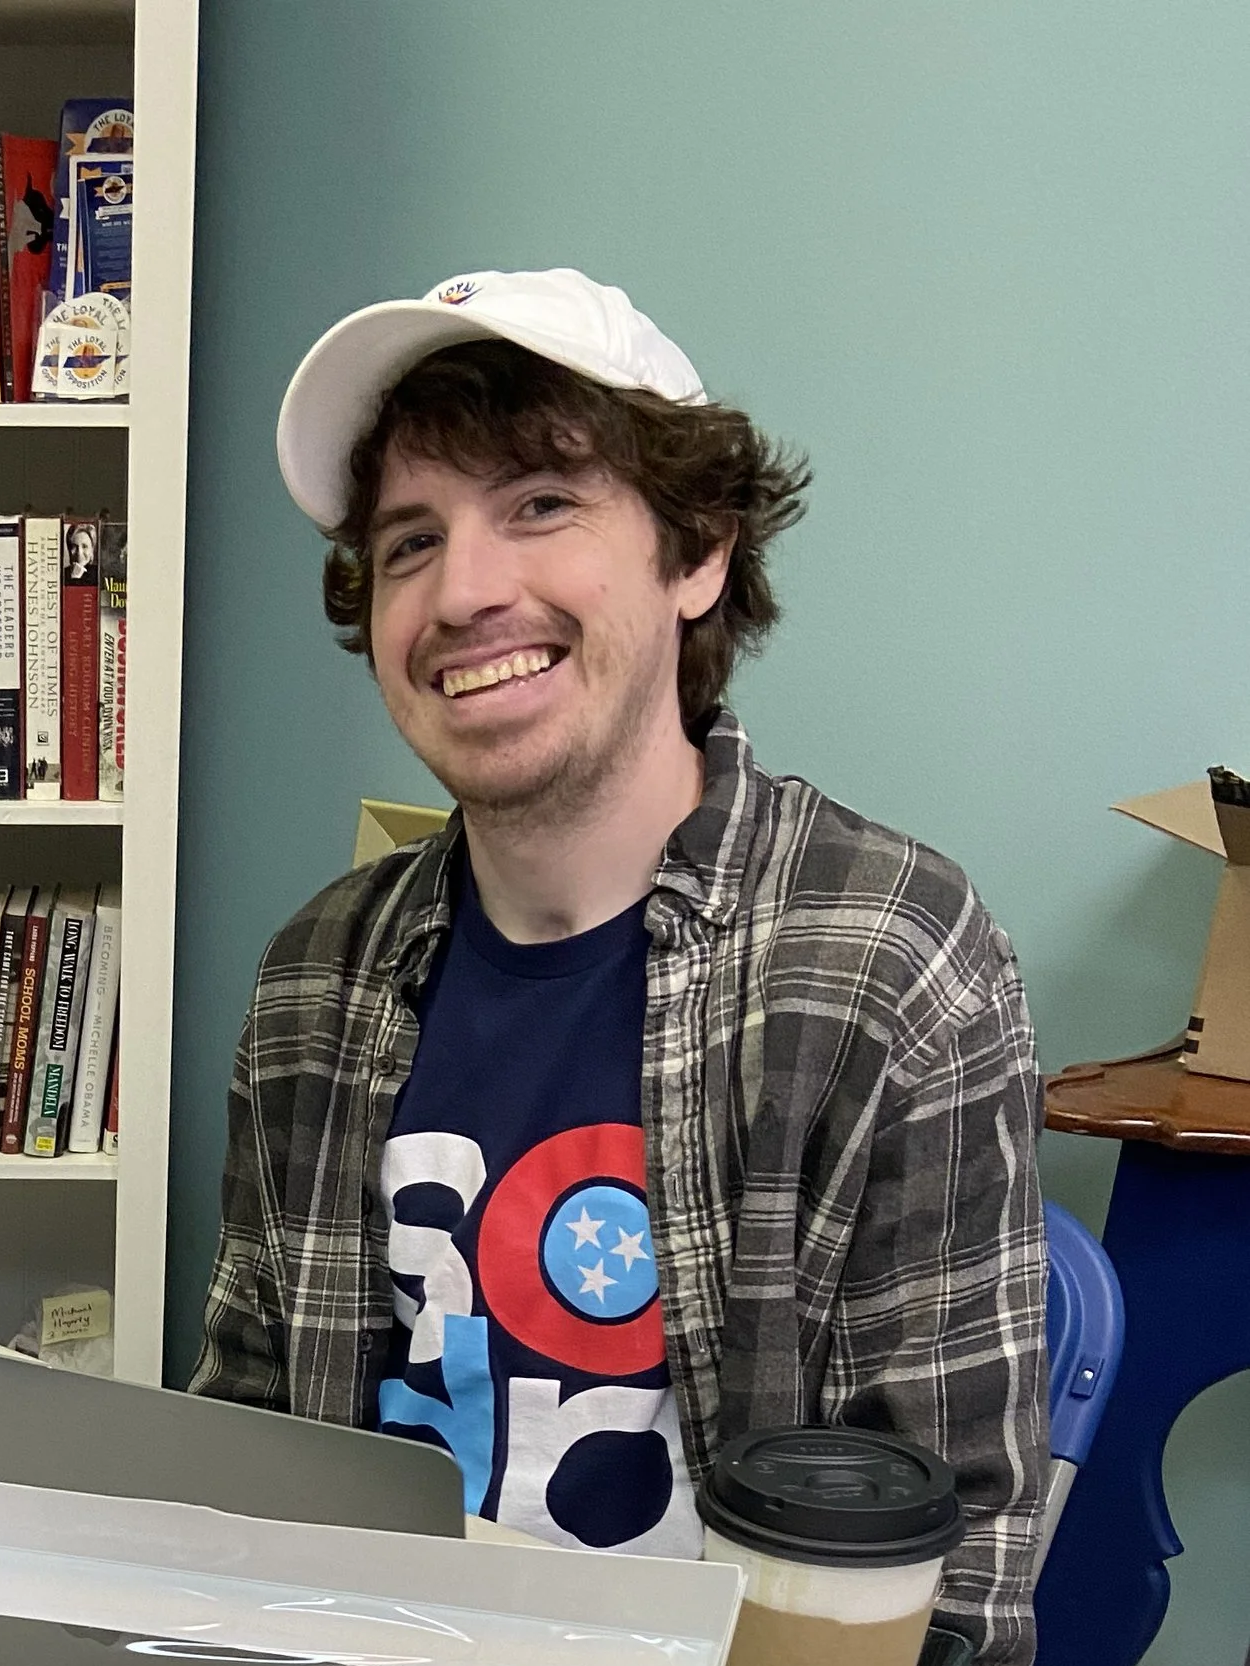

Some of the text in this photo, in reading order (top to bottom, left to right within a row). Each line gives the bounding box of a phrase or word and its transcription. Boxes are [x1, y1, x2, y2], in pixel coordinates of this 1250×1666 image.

[65, 369, 107, 389] OPPOSITION
[68, 334, 106, 351] THE LOYAL
[3, 566, 14, 659] THE LEADERS
[27, 541, 39, 710] HAYNES JOHNSON
[47, 533, 58, 717] THE BEST OF TIMES
[19, 967, 36, 1023] SCHOOL
[52, 920, 81, 1049] LONG WALK TO FREEDOM
[13, 1027, 30, 1071] MOMS
[80, 925, 114, 1128] BECOMING MICHELLE OBAMA
[43, 1067, 62, 1115] MANDELA
